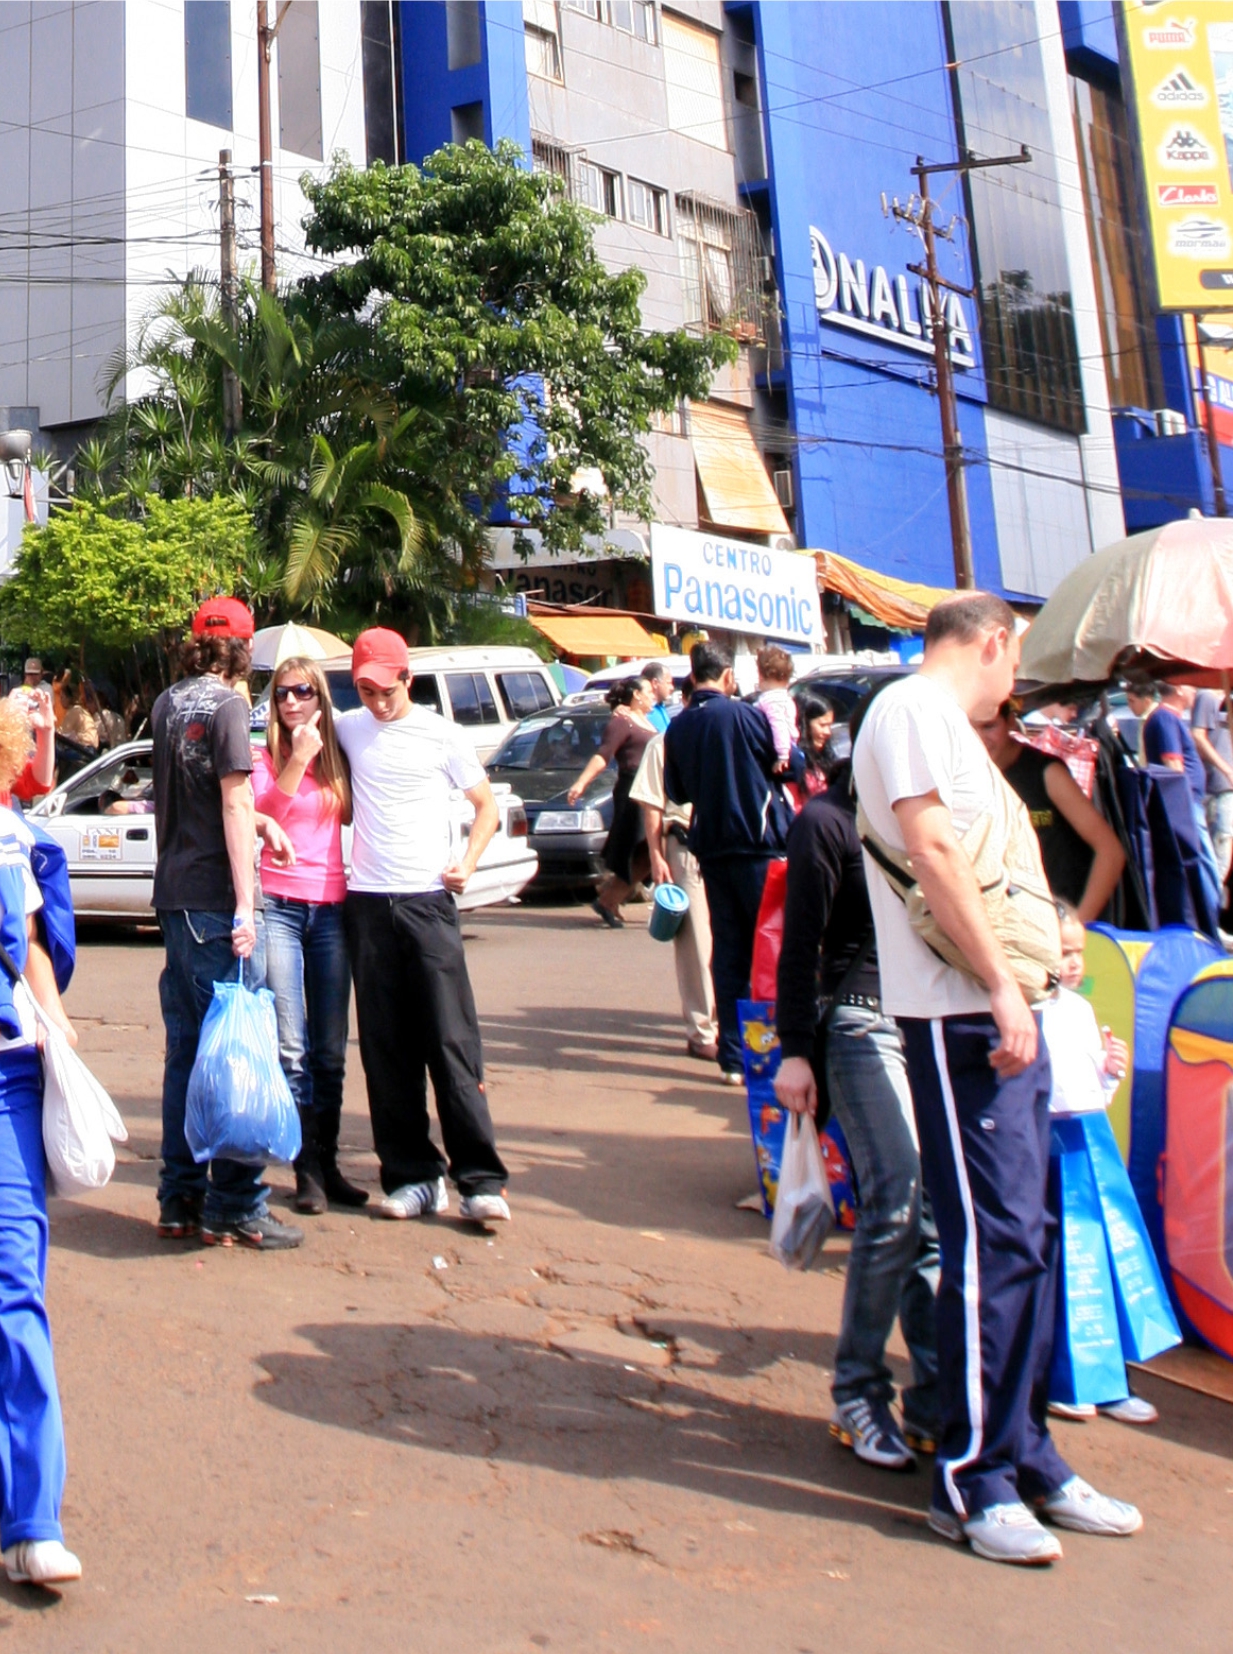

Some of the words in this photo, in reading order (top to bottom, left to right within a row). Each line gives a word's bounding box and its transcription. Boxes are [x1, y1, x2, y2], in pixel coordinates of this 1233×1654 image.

[1149, 32, 1186, 43] PUMA
[1157, 91, 1204, 101] adidas
[1166, 150, 1210, 162] Kappa
[1160, 186, 1218, 205] Clarks
[702, 542, 772, 576] CENTRO
[663, 562, 813, 635] Panasonic
